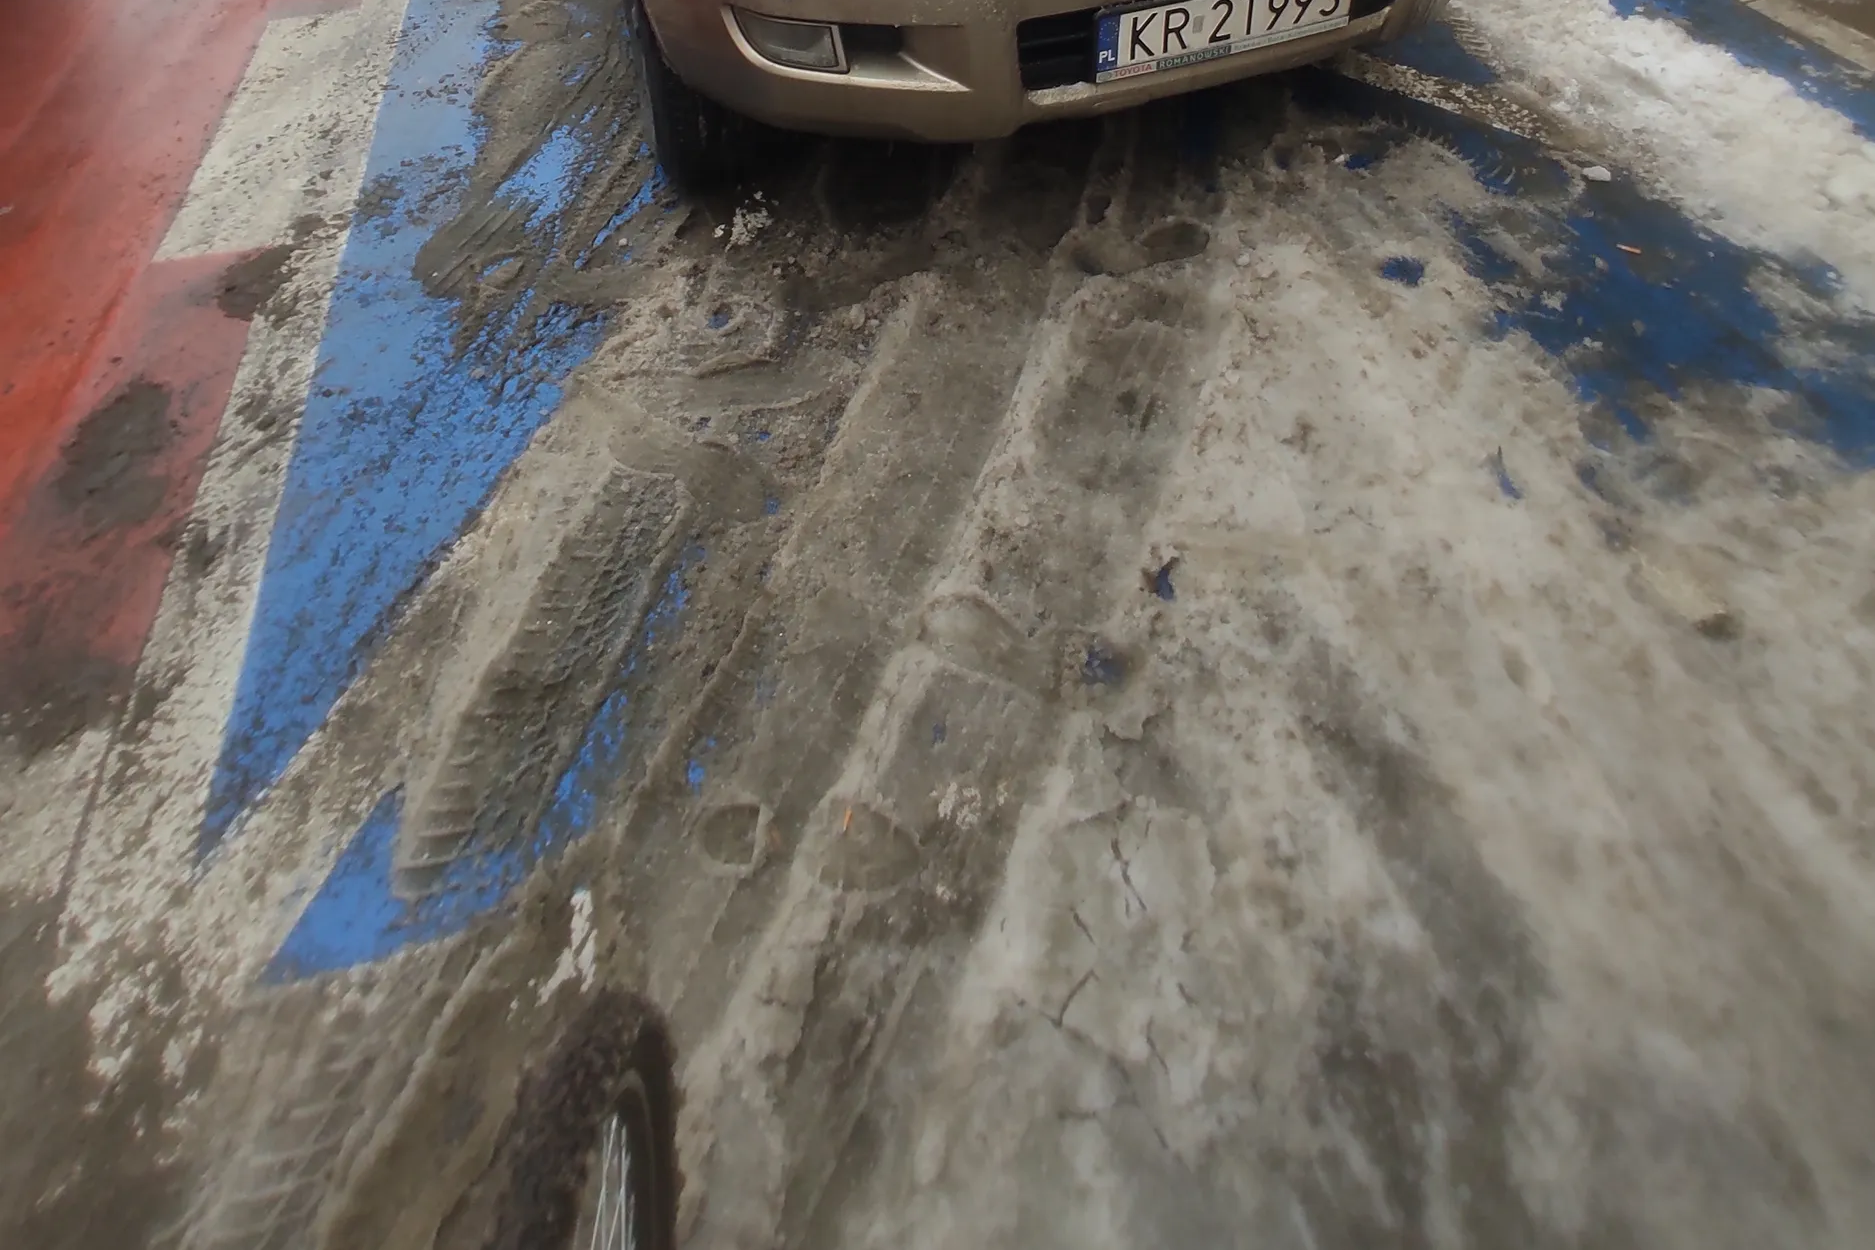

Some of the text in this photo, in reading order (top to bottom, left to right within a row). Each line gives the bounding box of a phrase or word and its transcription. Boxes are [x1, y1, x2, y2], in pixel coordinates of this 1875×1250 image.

[1130, 8, 1190, 61] KR
[1098, 49, 1116, 64] PL
[1114, 45, 1230, 78] TOYOTA ROMANOWSKI
